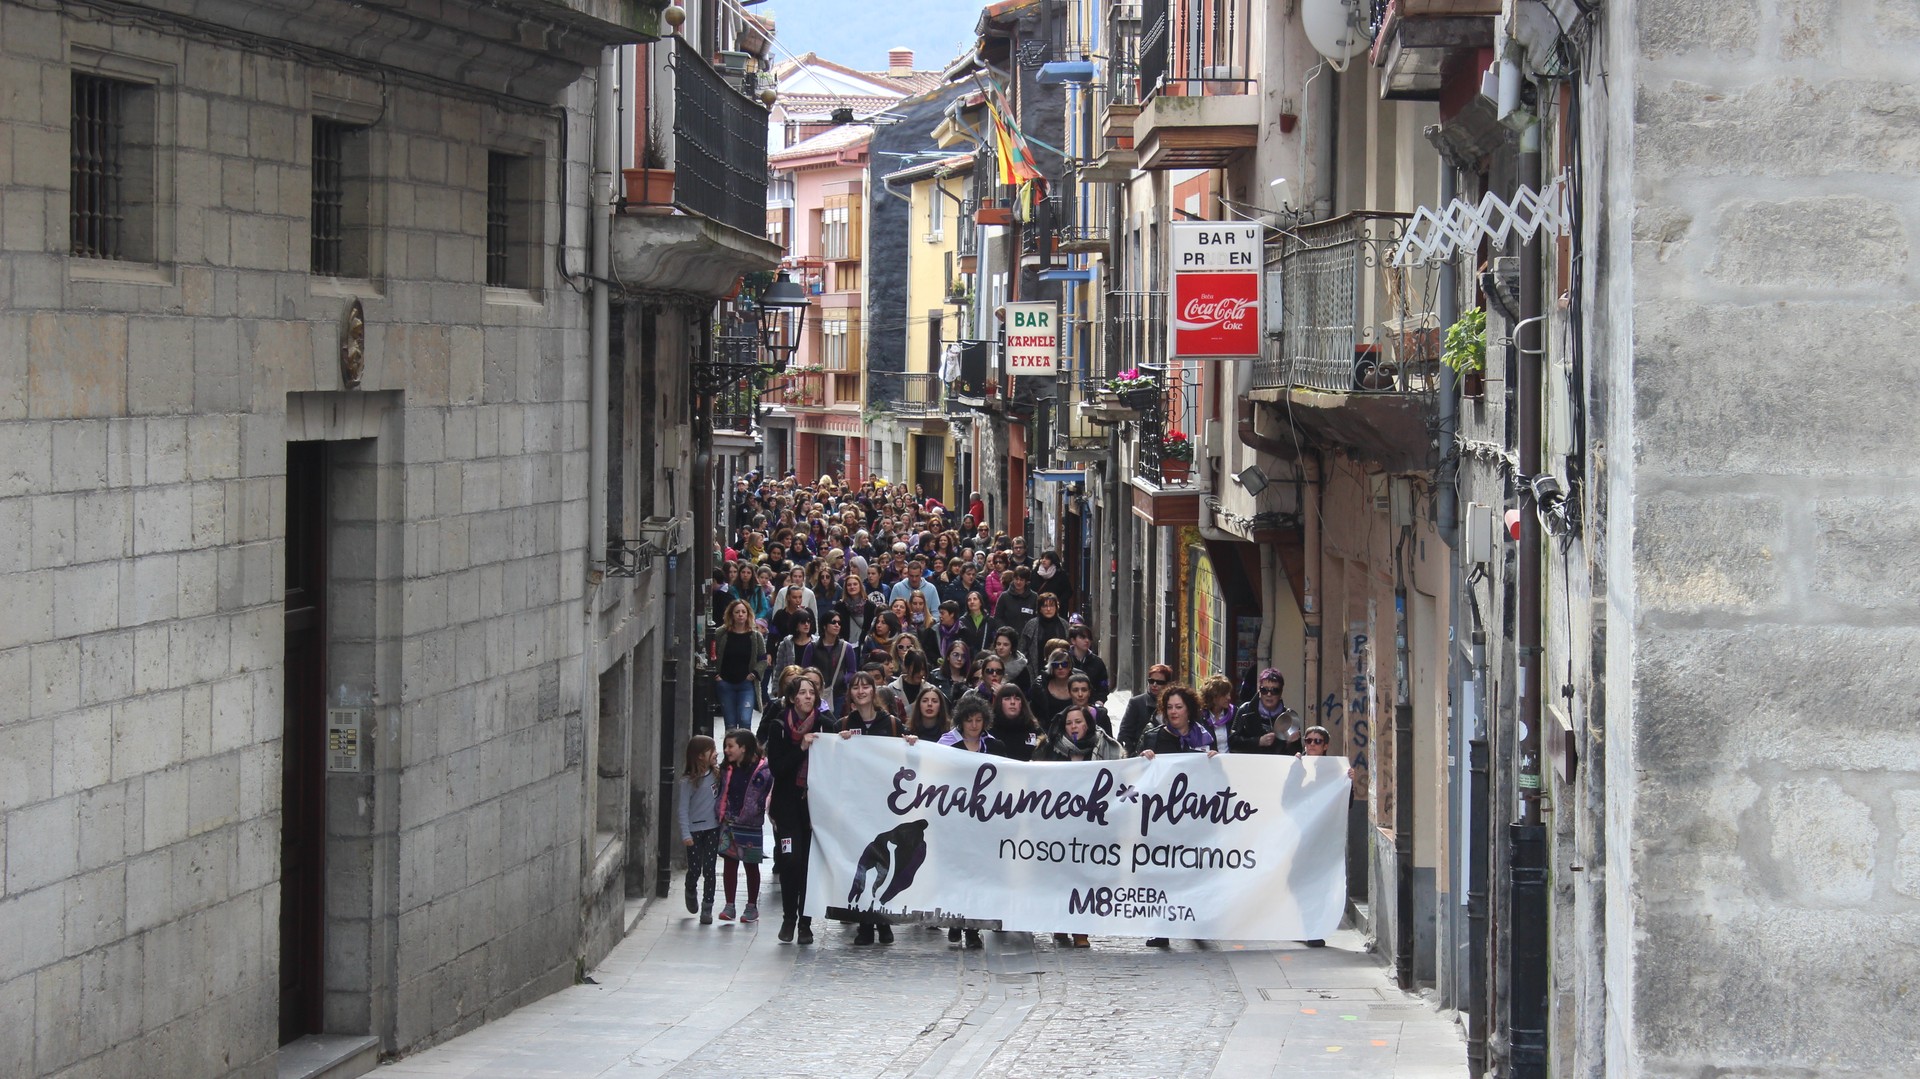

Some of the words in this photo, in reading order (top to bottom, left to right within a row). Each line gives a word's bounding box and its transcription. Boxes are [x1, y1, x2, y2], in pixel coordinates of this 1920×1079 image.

[1198, 232, 1235, 245] BAR
[1184, 298, 1248, 321] Coca-Cola
[1015, 311, 1049, 327] BAR
[1222, 320, 1243, 330] Coke
[1007, 335, 1056, 347] KARMELE
[1012, 355, 1051, 367] ETXEA
[1141, 772, 1258, 836] planto
[999, 836, 1121, 866] nosotras
[1131, 842, 1257, 873] paramos
[1068, 886, 1113, 917] M8
[1113, 887, 1168, 904] GREBA
[1114, 903, 1196, 922] FEMINISTA
